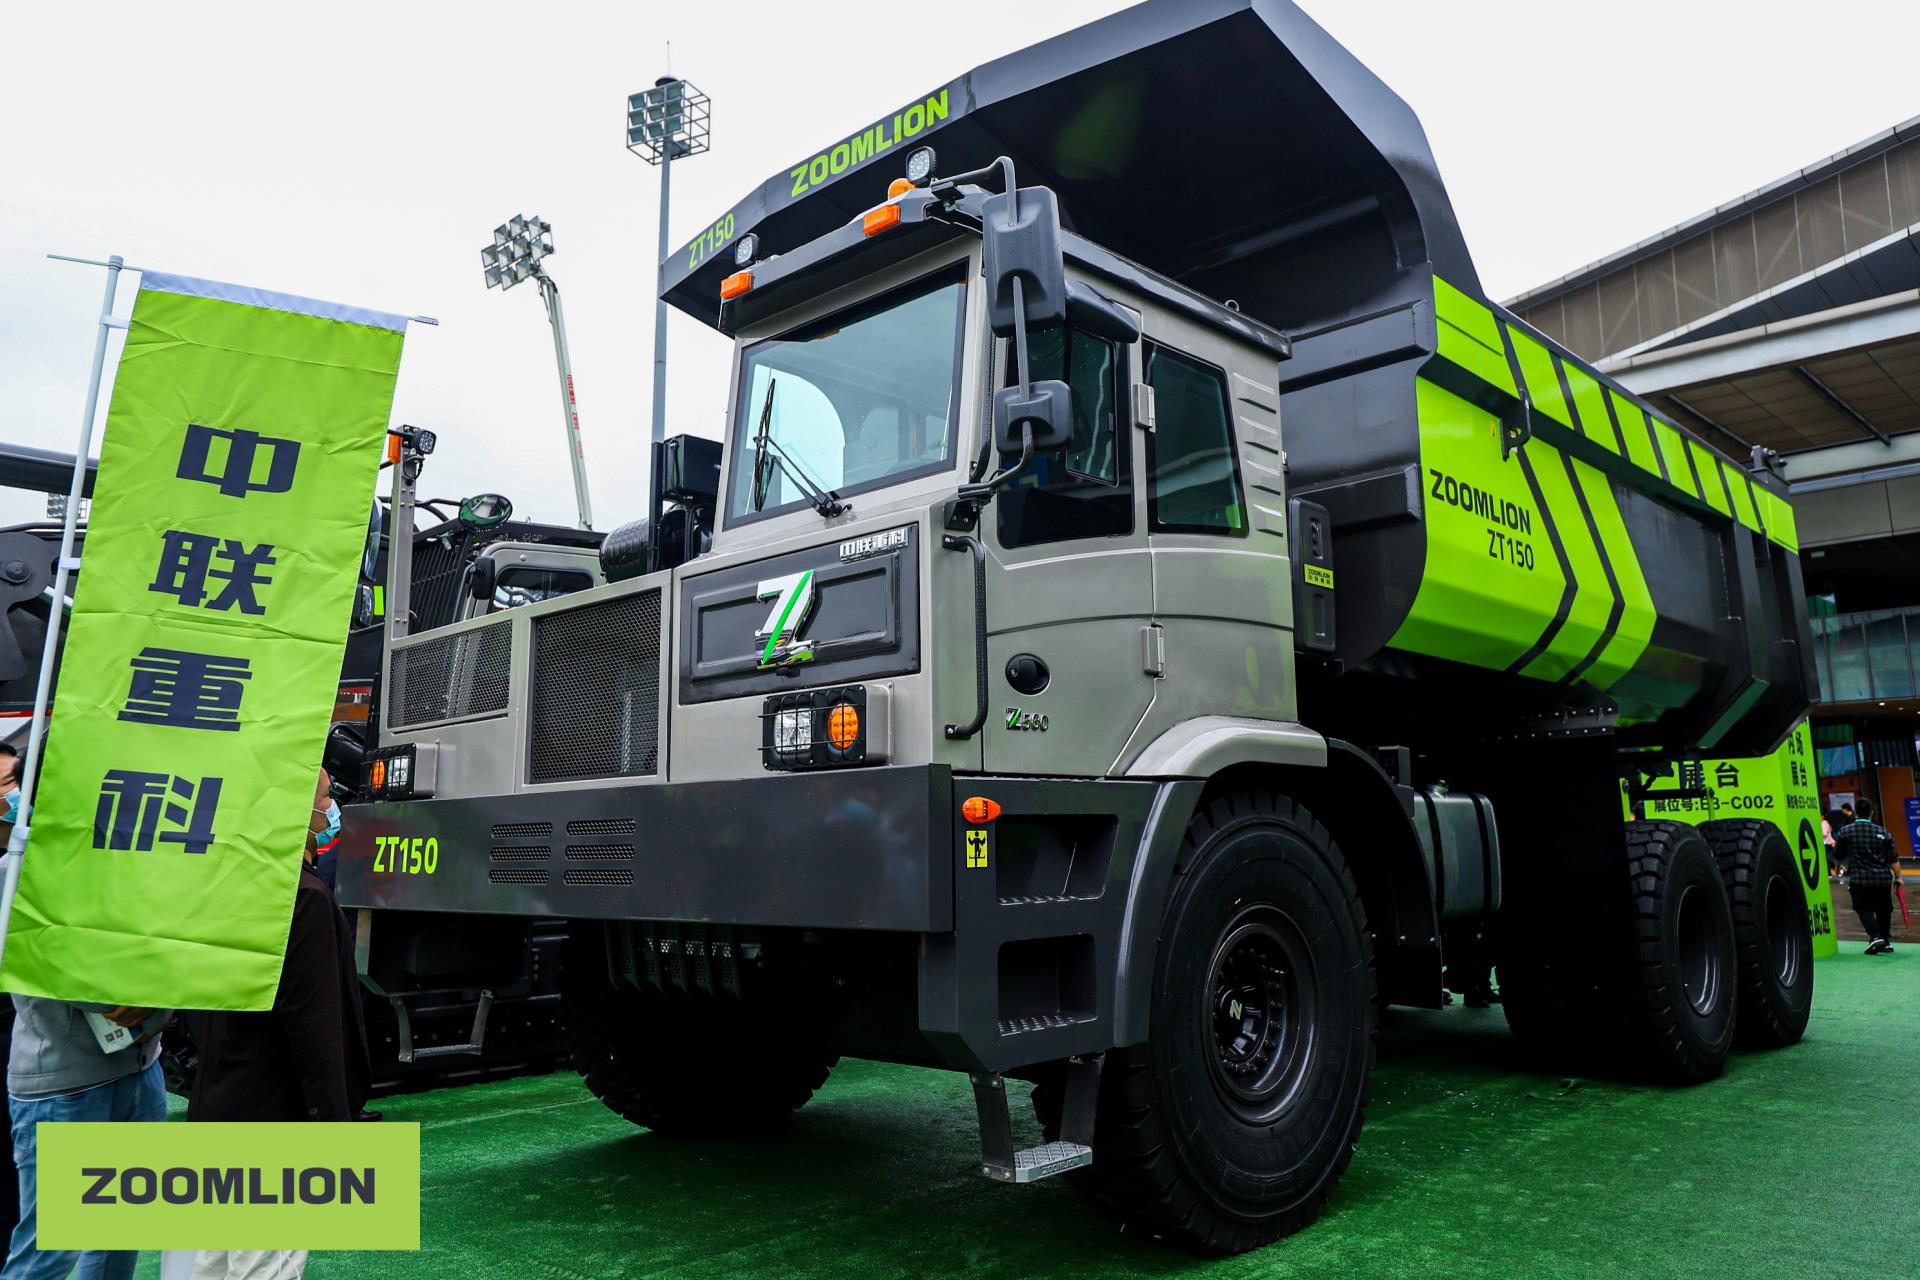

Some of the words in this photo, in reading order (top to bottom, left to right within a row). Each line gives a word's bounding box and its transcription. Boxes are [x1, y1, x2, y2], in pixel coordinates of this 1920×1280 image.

[790, 89, 950, 196] ZOOMLION
[689, 213, 735, 270] ZT150
[1429, 468, 1532, 536] ZOOMLION
[839, 527, 909, 560] 中联重科
[1486, 528, 1535, 571] ZT150
[93, 424, 301, 853] 中联重科
[373, 836, 439, 875] ZT150
